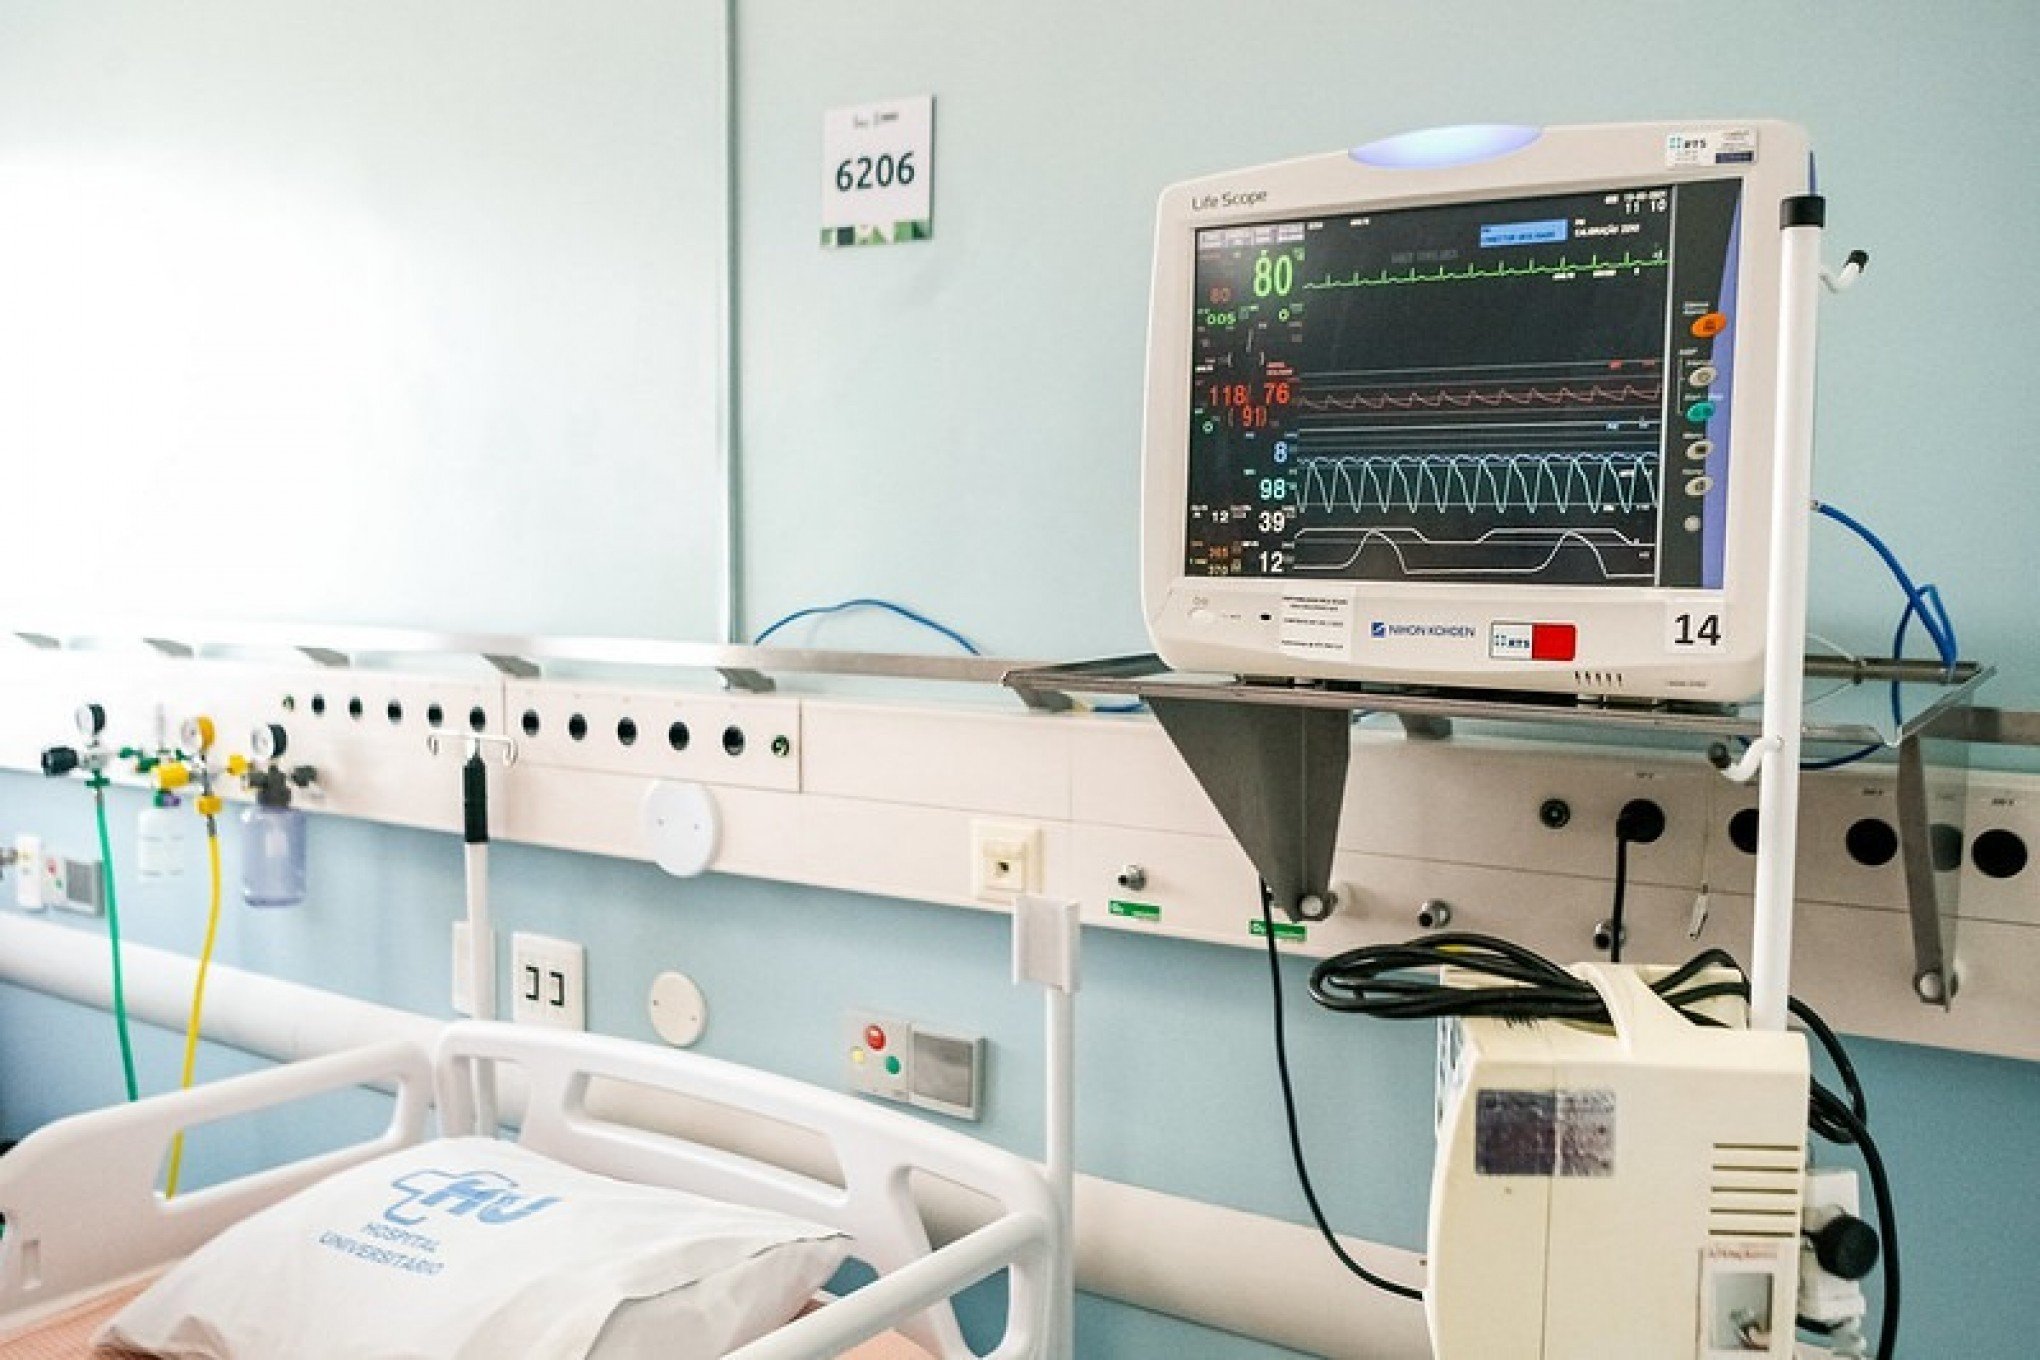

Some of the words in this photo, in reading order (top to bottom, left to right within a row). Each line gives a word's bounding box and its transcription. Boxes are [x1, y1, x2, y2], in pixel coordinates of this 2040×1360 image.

[836, 151, 915, 191] 6206
[1192, 195, 1218, 210] Life
[1222, 190, 1267, 207] Scope
[1253, 255, 1293, 297] 80
[1264, 382, 1290, 405] 76
[1273, 442, 1288, 463] 8
[1259, 480, 1286, 500] 98
[1258, 510, 1286, 533] 39
[1258, 551, 1284, 573] 12
[1388, 624, 1426, 637] NIHON
[1674, 615, 1722, 647] 14
[362, 1222, 440, 1252] HOSPITAL
